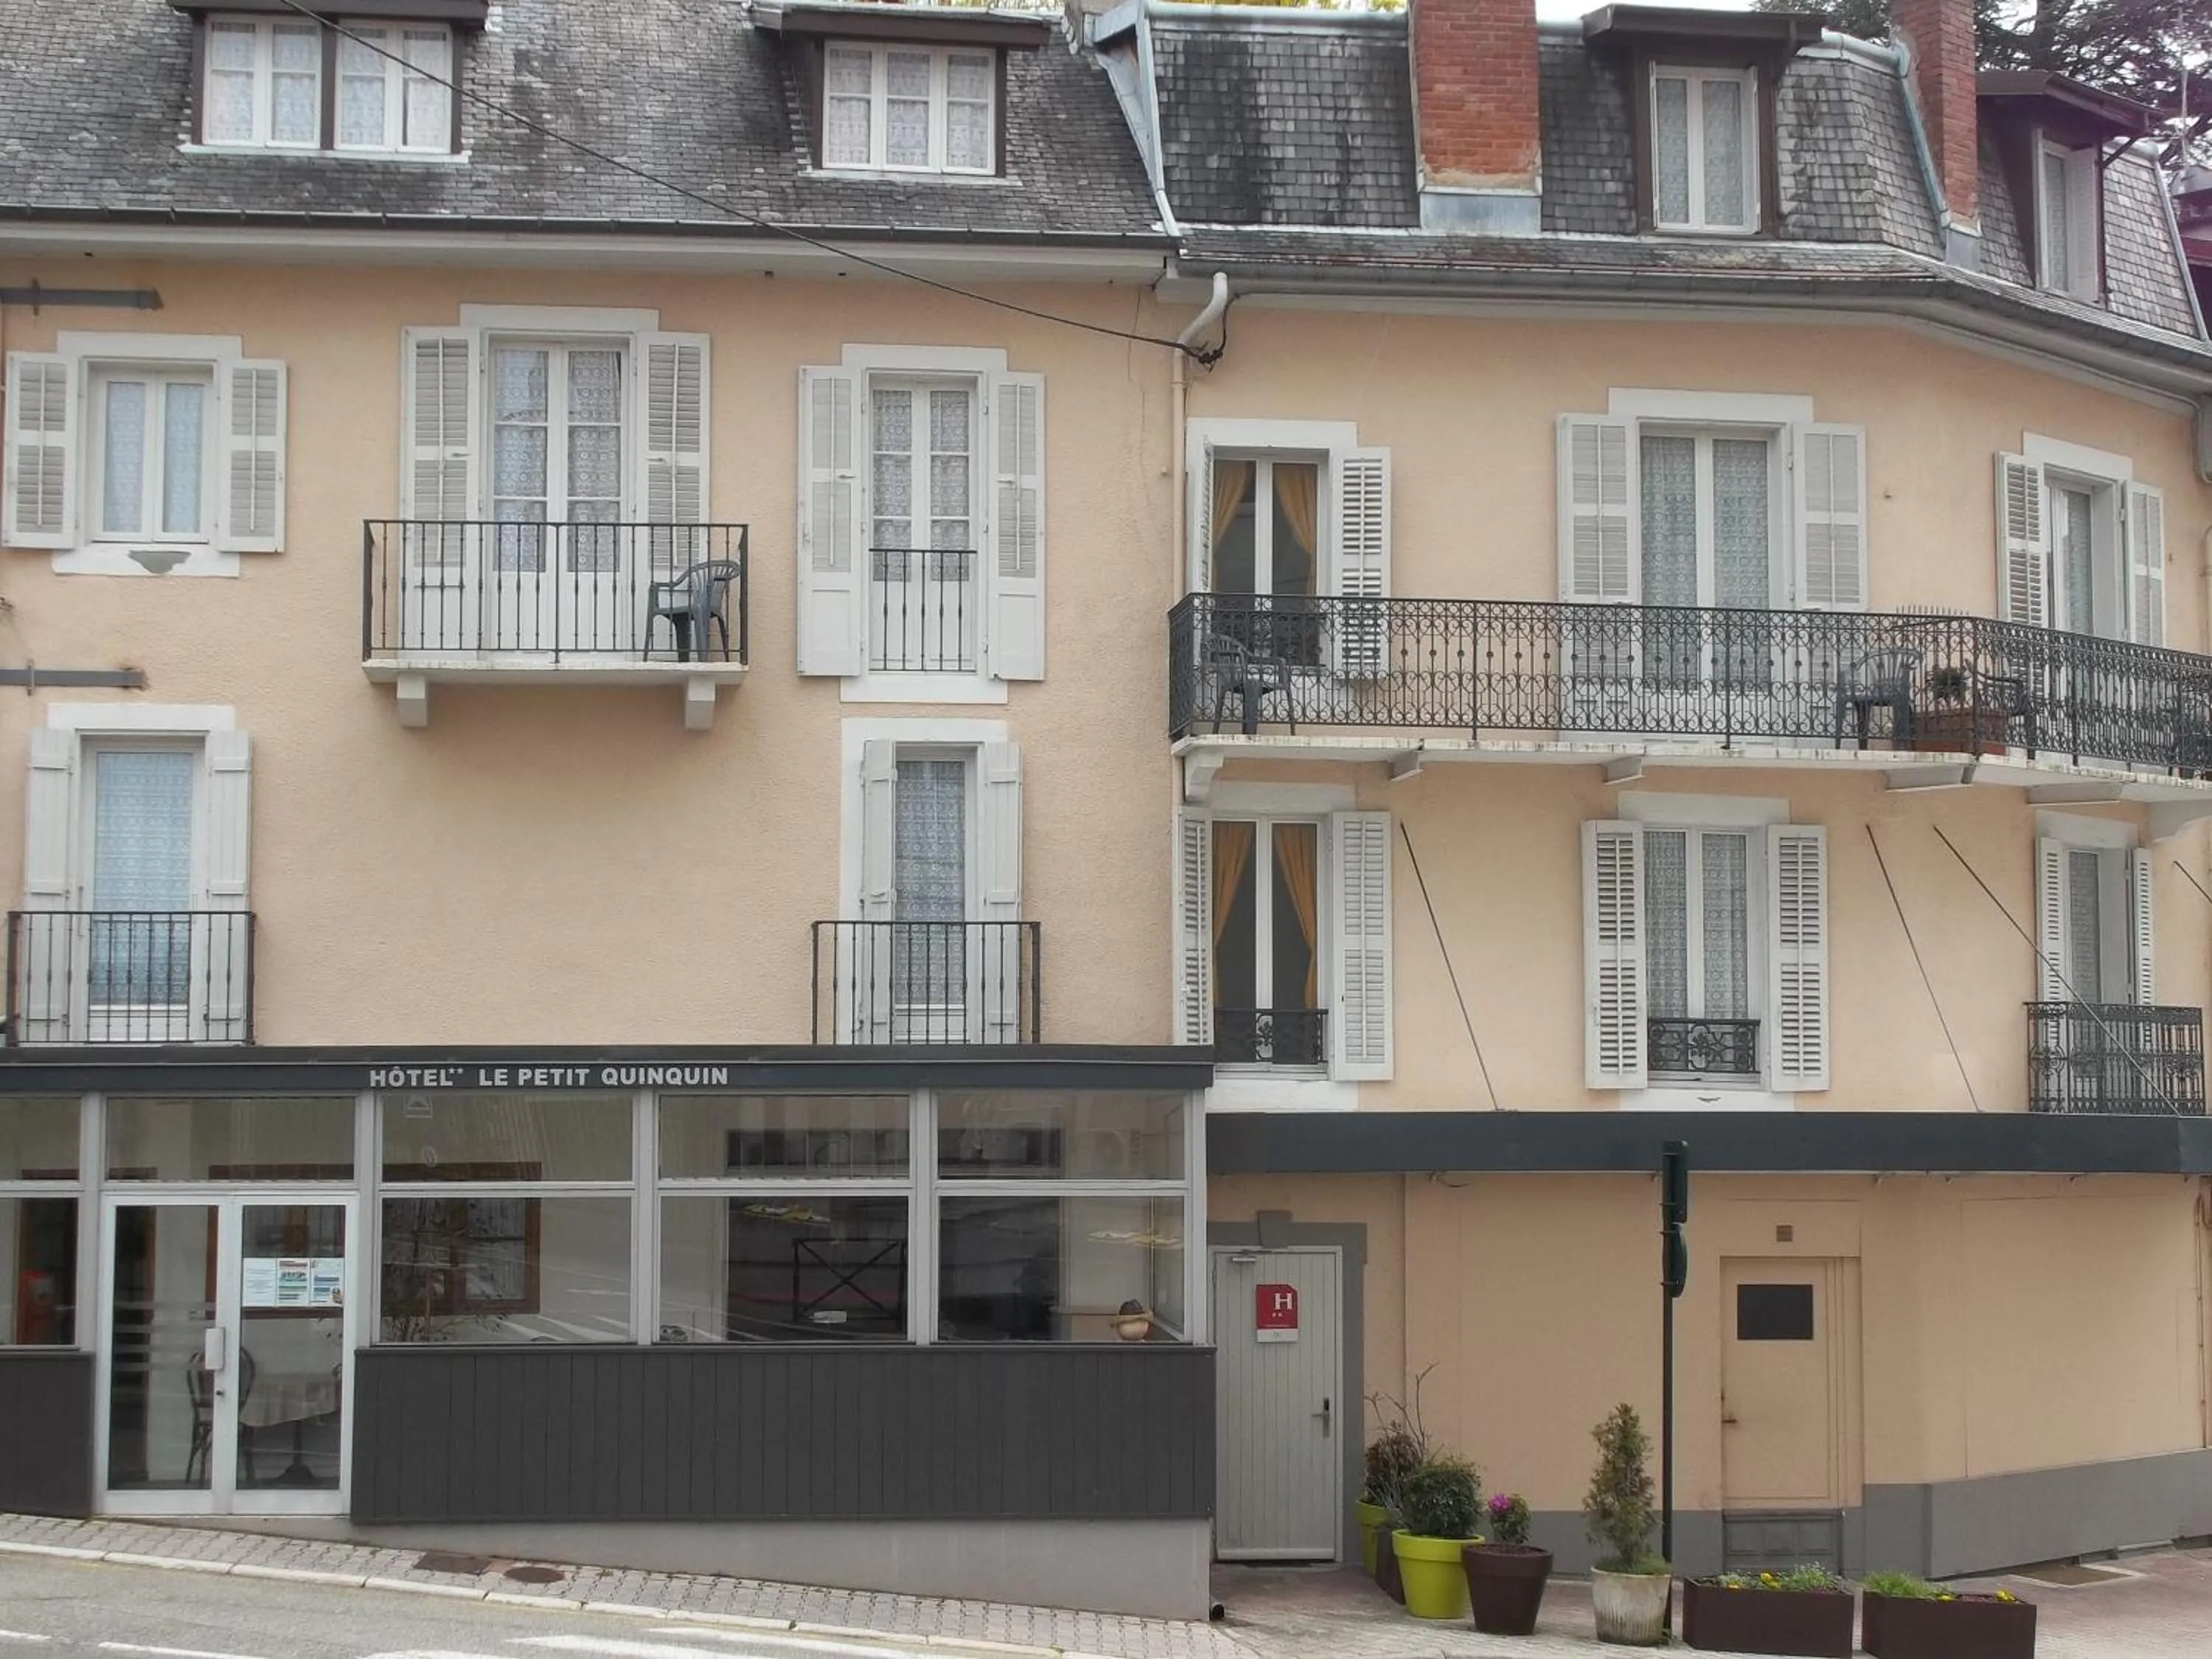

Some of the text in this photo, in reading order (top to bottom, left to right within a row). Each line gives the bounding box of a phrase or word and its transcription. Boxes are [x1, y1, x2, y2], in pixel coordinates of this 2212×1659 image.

[479, 1068, 508, 1086] LE
[518, 1068, 591, 1086] PETIT
[601, 1067, 728, 1086] QUINQUIN
[1274, 1293, 1293, 1310] H
